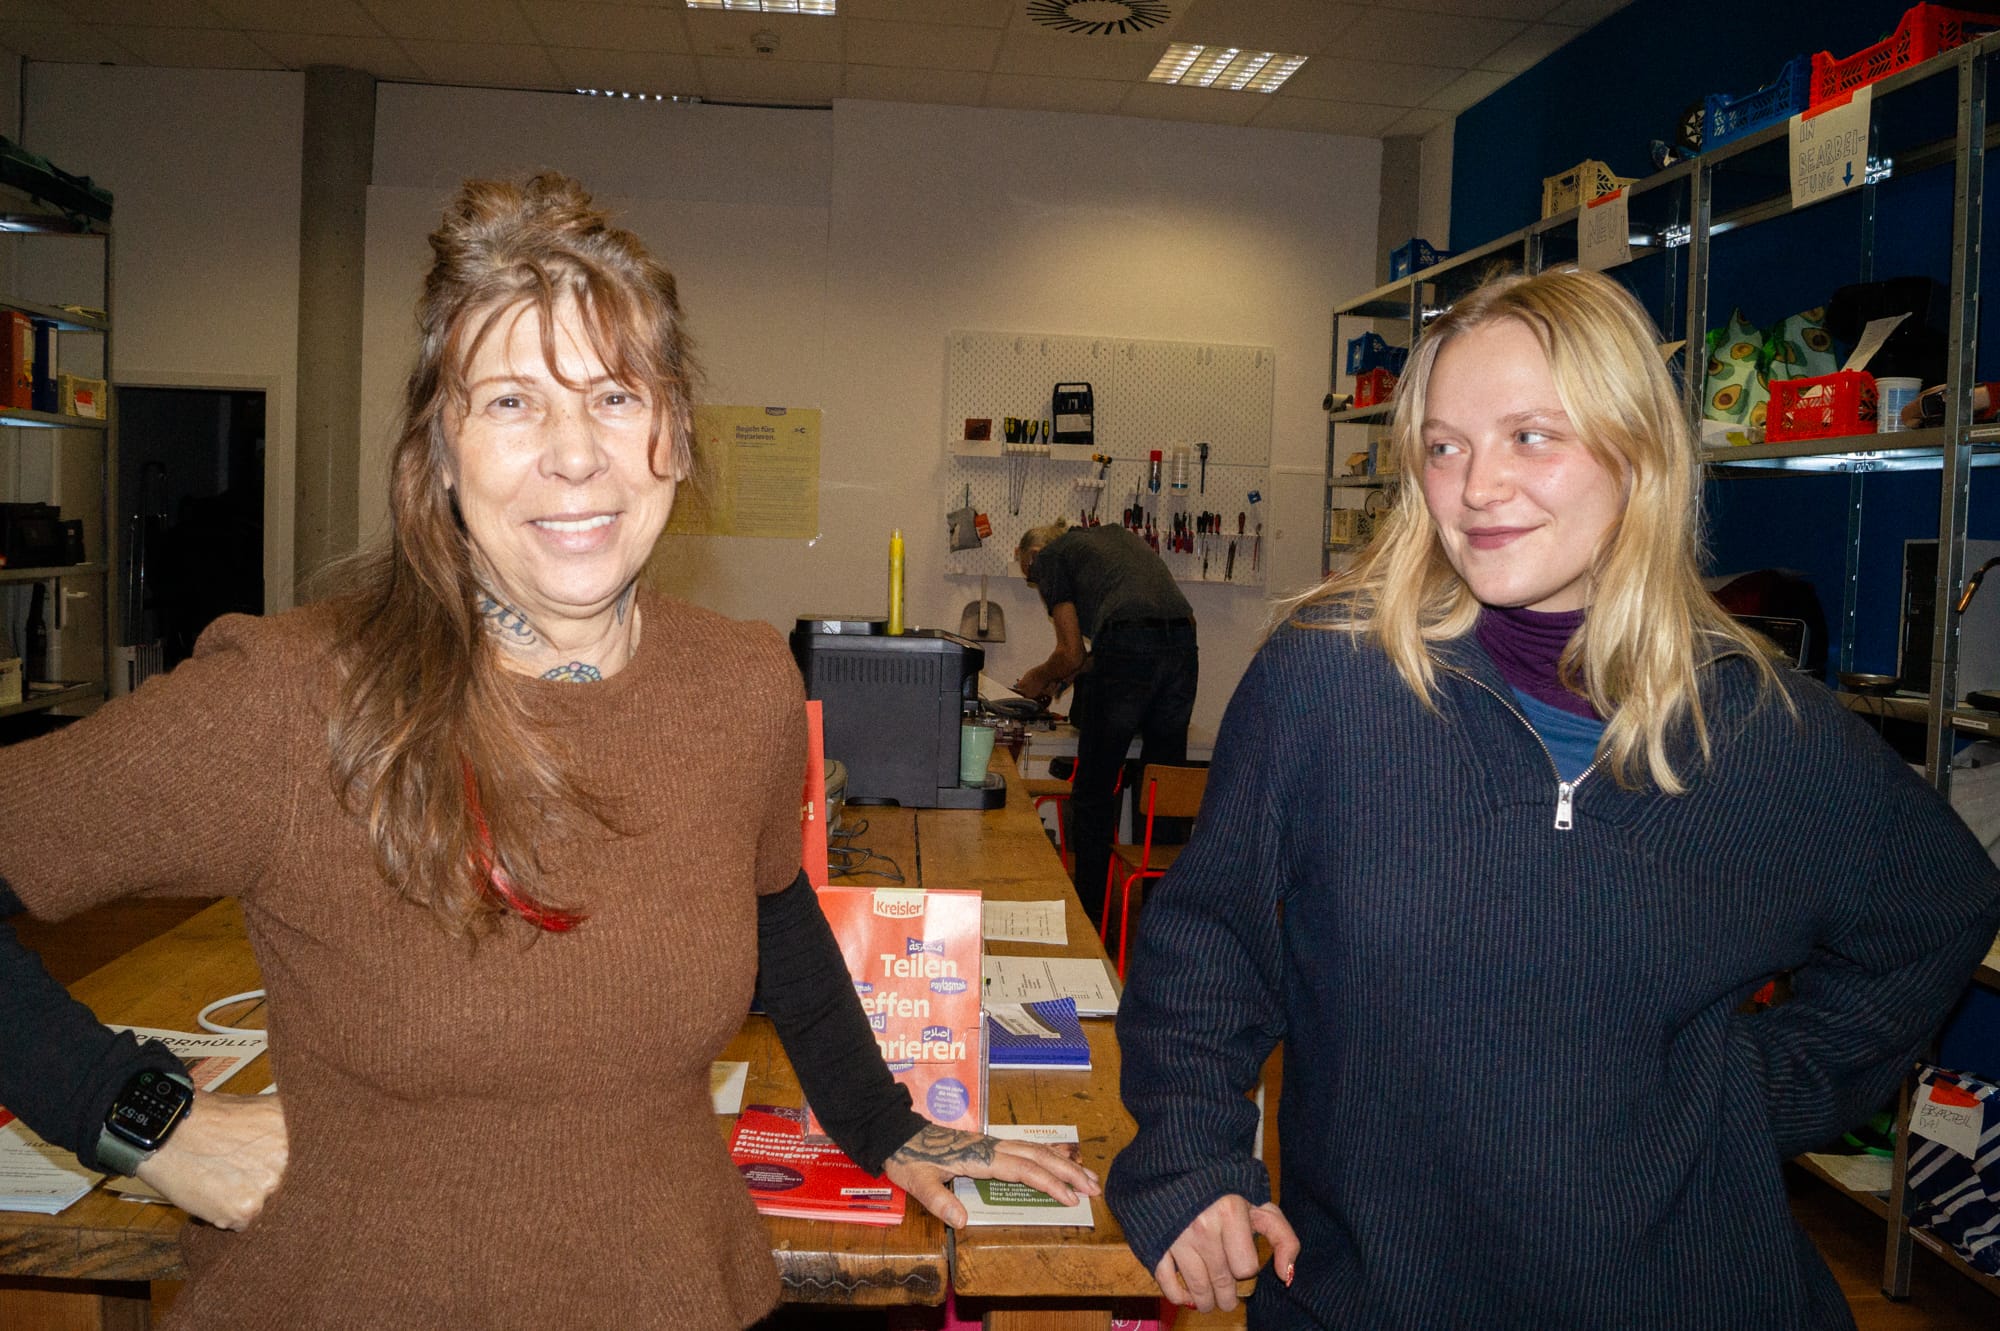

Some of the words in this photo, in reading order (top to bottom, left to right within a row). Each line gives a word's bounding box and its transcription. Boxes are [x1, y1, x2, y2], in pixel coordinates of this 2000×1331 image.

[1800, 118, 1816, 143] IN
[876, 901, 922, 916] Kreisler
[880, 953, 957, 978] Teilen
[861, 992, 930, 1018] effen
[118, 1105, 149, 1126] 16:57
